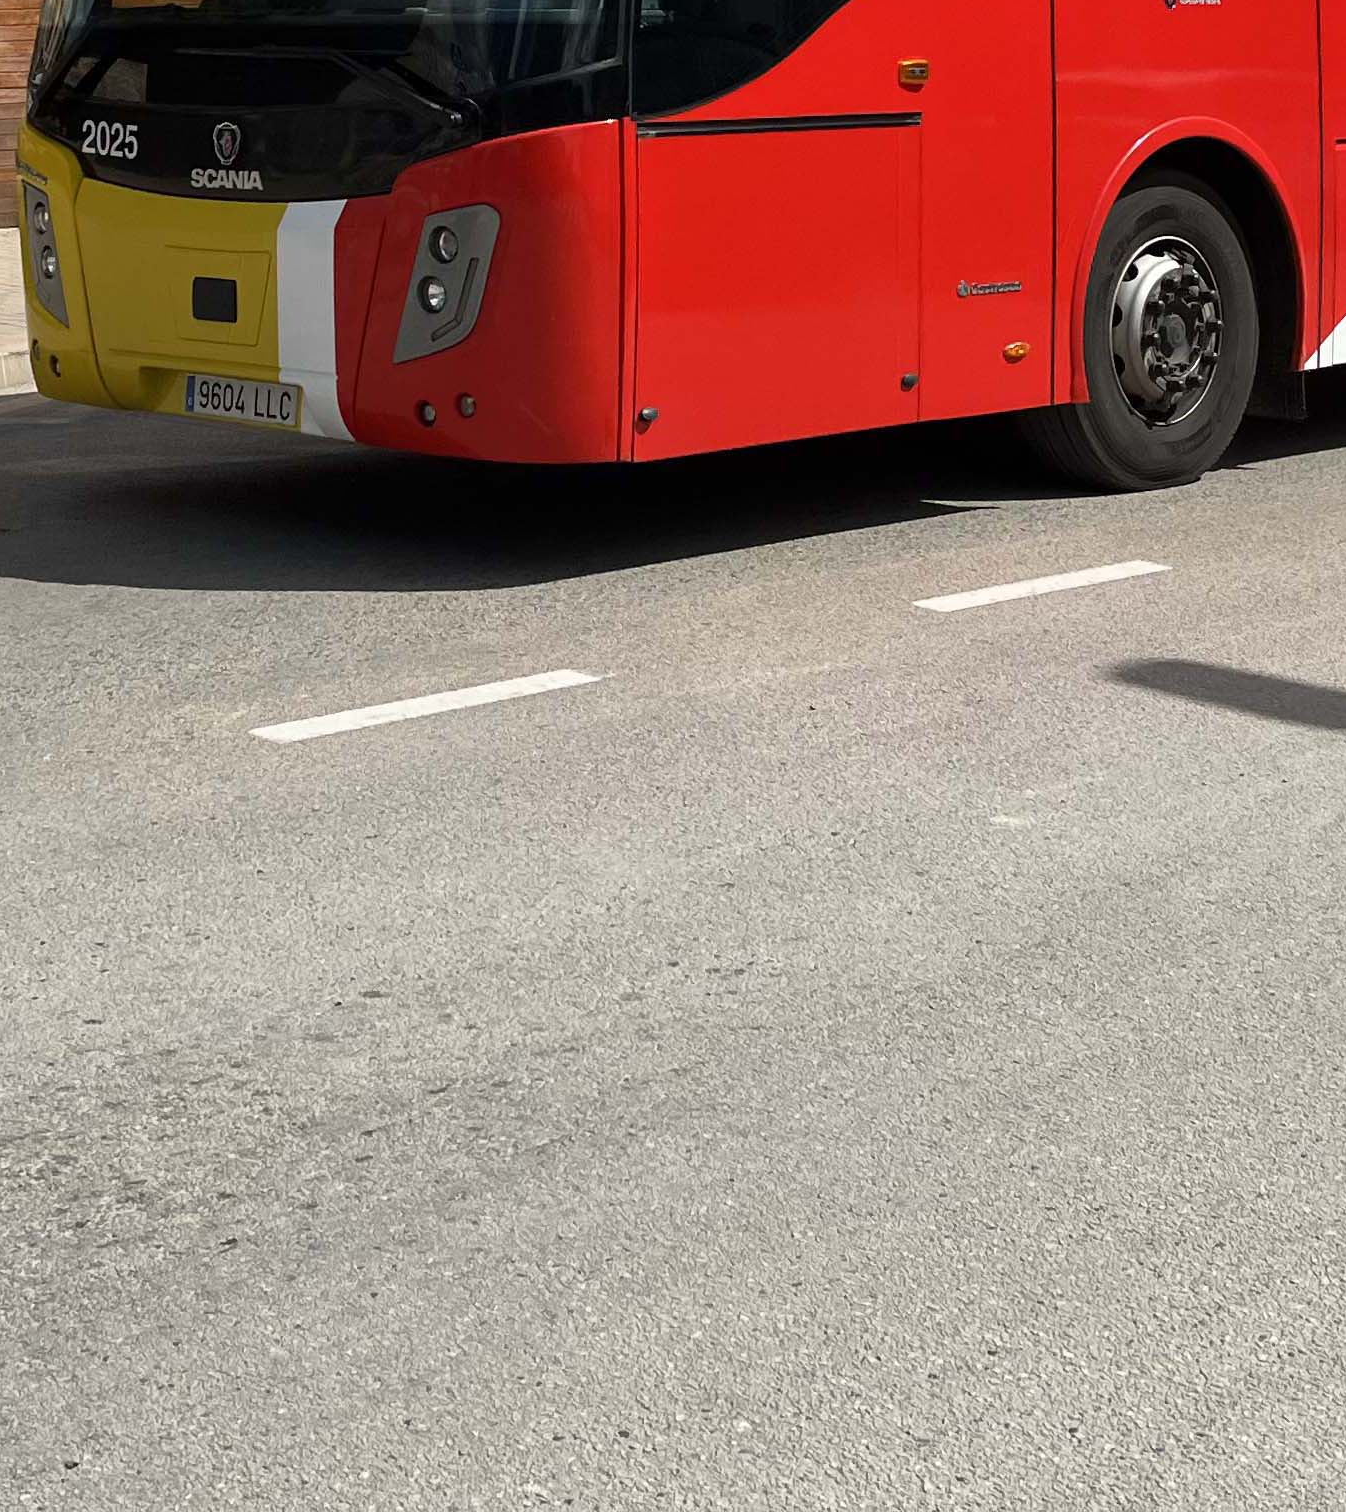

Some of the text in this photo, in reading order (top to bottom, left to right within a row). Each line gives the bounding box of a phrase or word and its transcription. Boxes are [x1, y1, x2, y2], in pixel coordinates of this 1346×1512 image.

[81, 119, 139, 159] 2025
[190, 168, 264, 191] SCANIA
[199, 380, 291, 420] 9604 LLC
